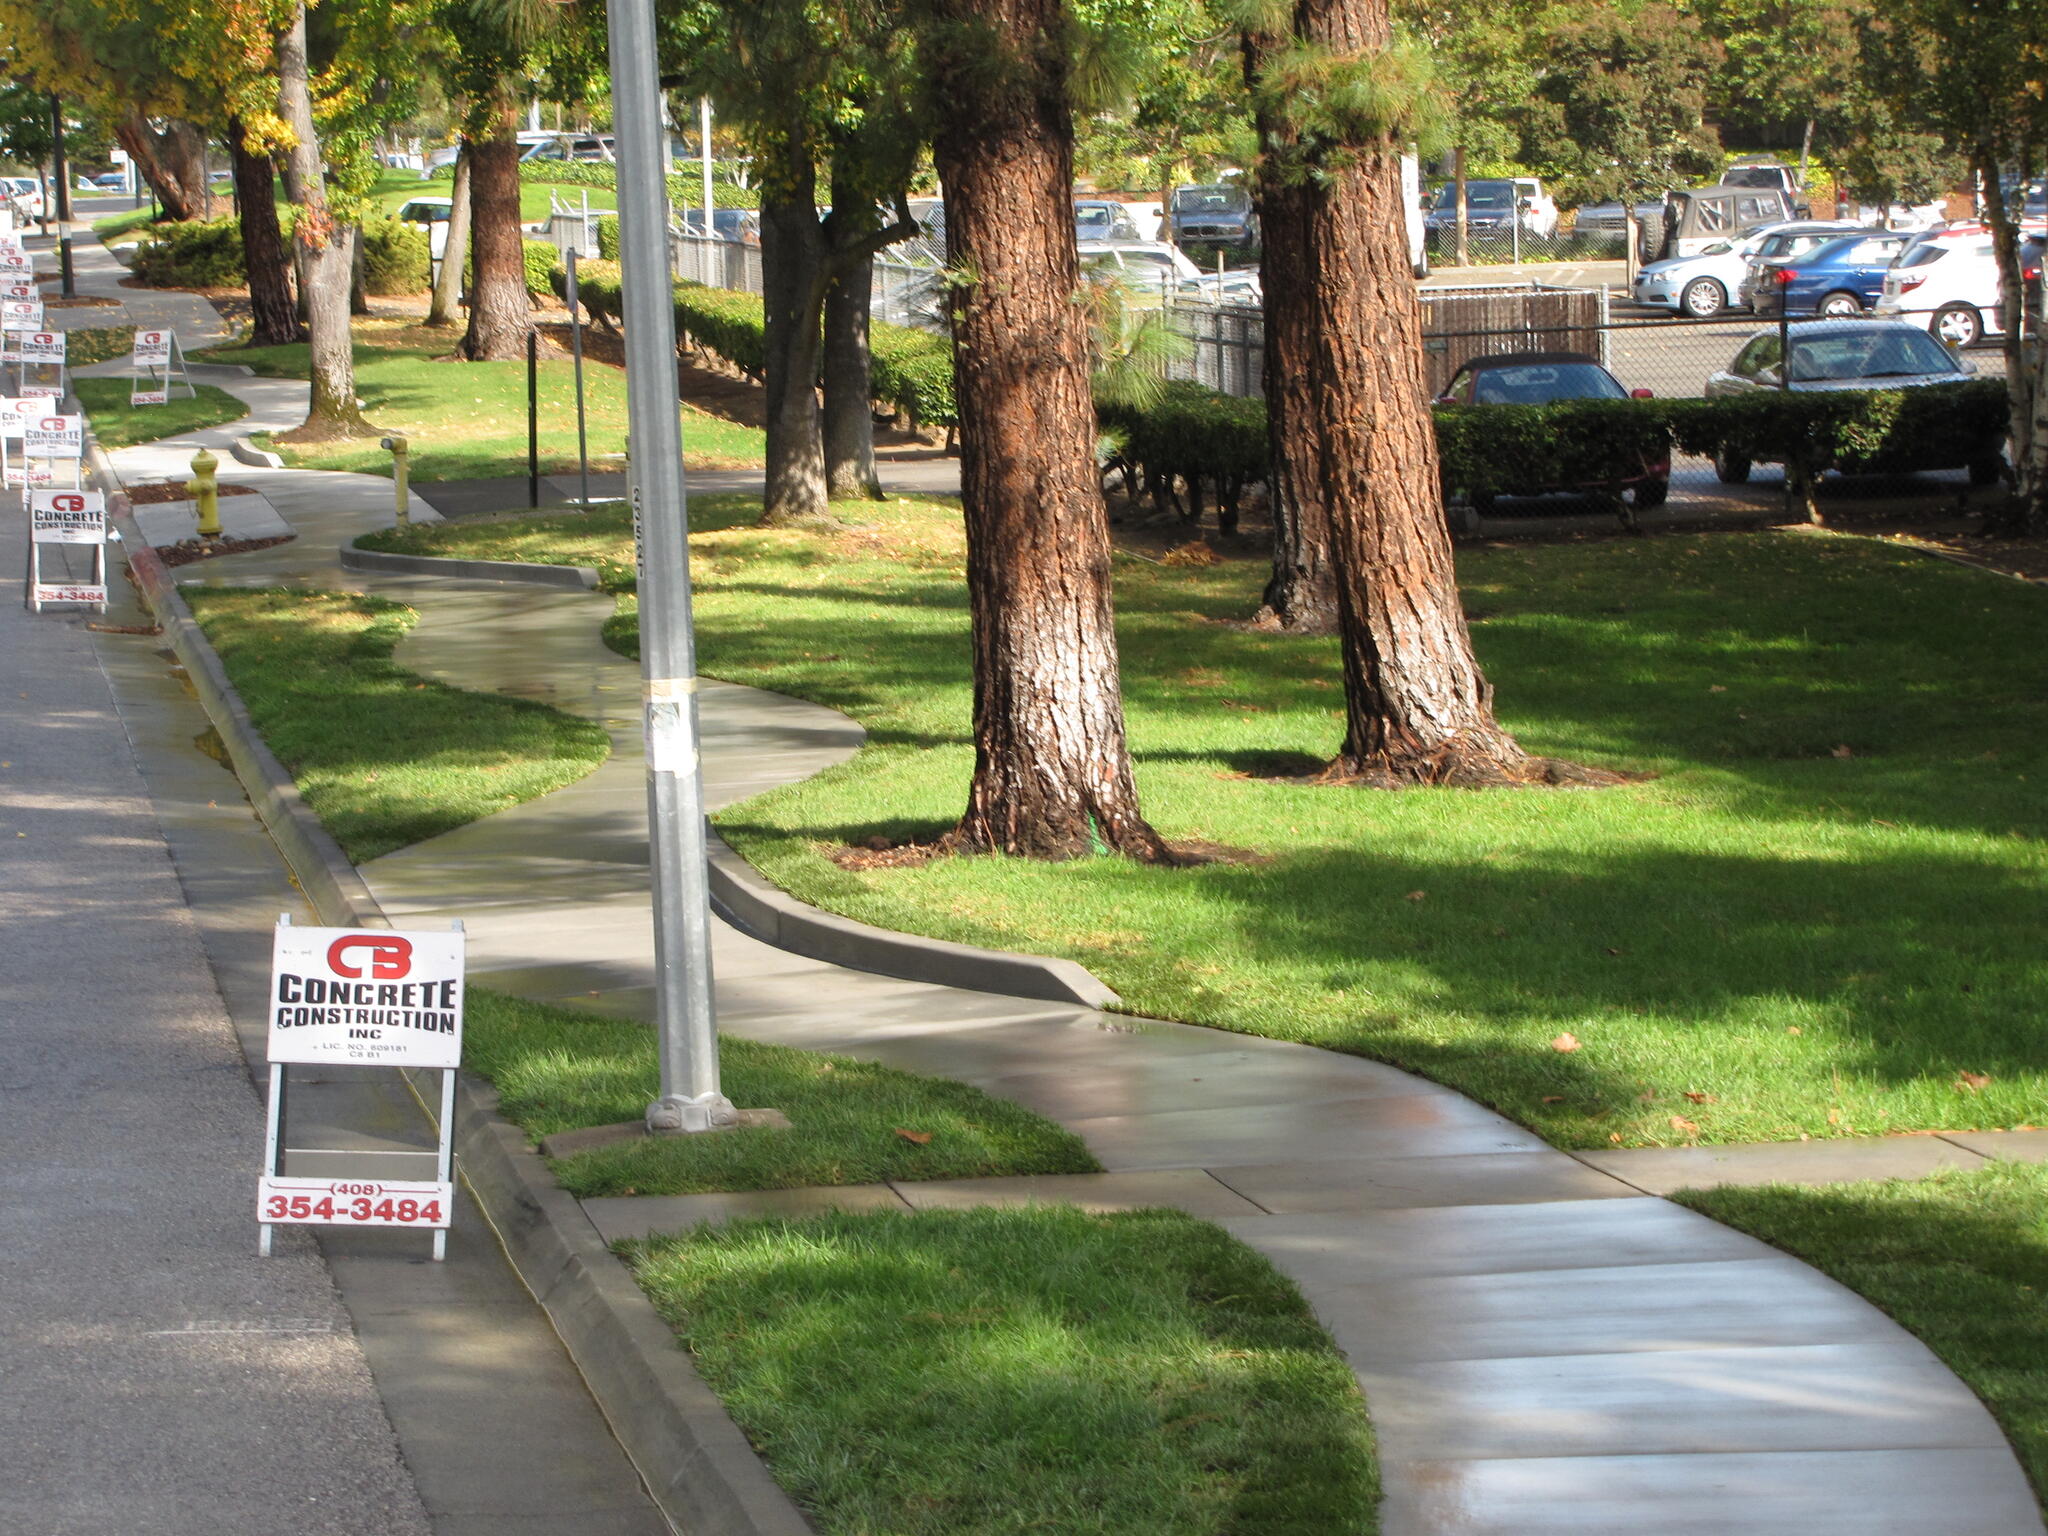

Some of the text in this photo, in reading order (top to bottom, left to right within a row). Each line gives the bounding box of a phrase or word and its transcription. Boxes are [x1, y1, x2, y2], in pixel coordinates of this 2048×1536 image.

[11, 287, 28, 296] CB
[15, 304, 32, 314] CB
[34, 334, 52, 344] CB
[145, 332, 160, 344] CB
[22, 342, 64, 352] CONCRETE
[40, 418, 66, 431] CB
[25, 430, 80, 440] CONCRETE
[52, 494, 84, 512] CB
[34, 510, 103, 522] CONCRETE
[34, 522, 103, 532] CONSTRUCTION
[38, 590, 105, 601] 354-3484
[327, 934, 412, 979] CB
[278, 973, 456, 1010] CONCRETE
[277, 1007, 455, 1036] CONSTRUCTION
[349, 1028, 382, 1040] INC
[330, 1183, 384, 1196] (408)
[266, 1195, 442, 1223] 354-3484
